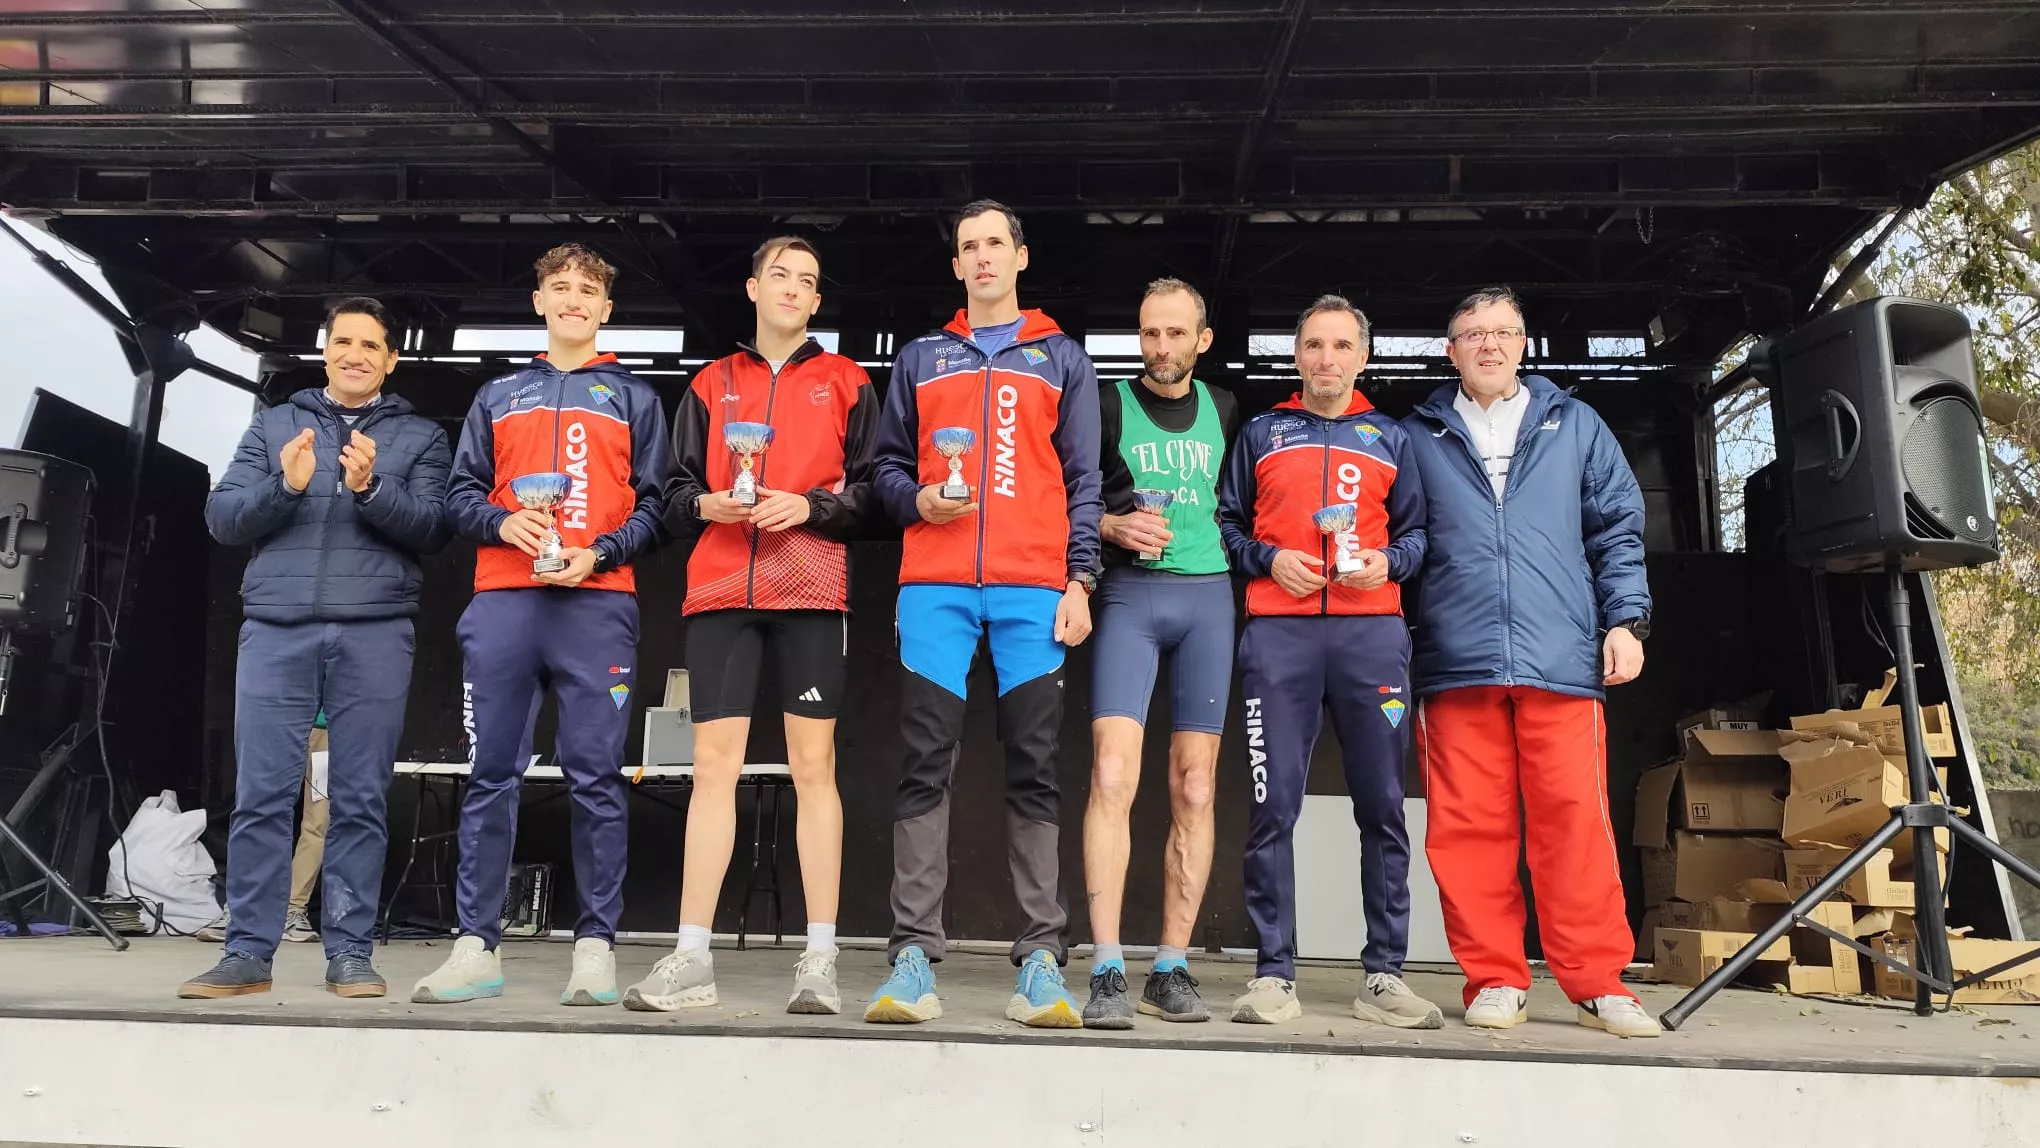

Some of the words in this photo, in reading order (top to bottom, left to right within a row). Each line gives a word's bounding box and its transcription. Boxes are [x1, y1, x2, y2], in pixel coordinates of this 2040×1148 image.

[564, 422, 588, 529] HINACO
[994, 385, 1018, 498] HINACO
[1132, 442, 1170, 475] EL
[1246, 697, 1268, 804] HINACO
[1729, 722, 1748, 730] MUY
